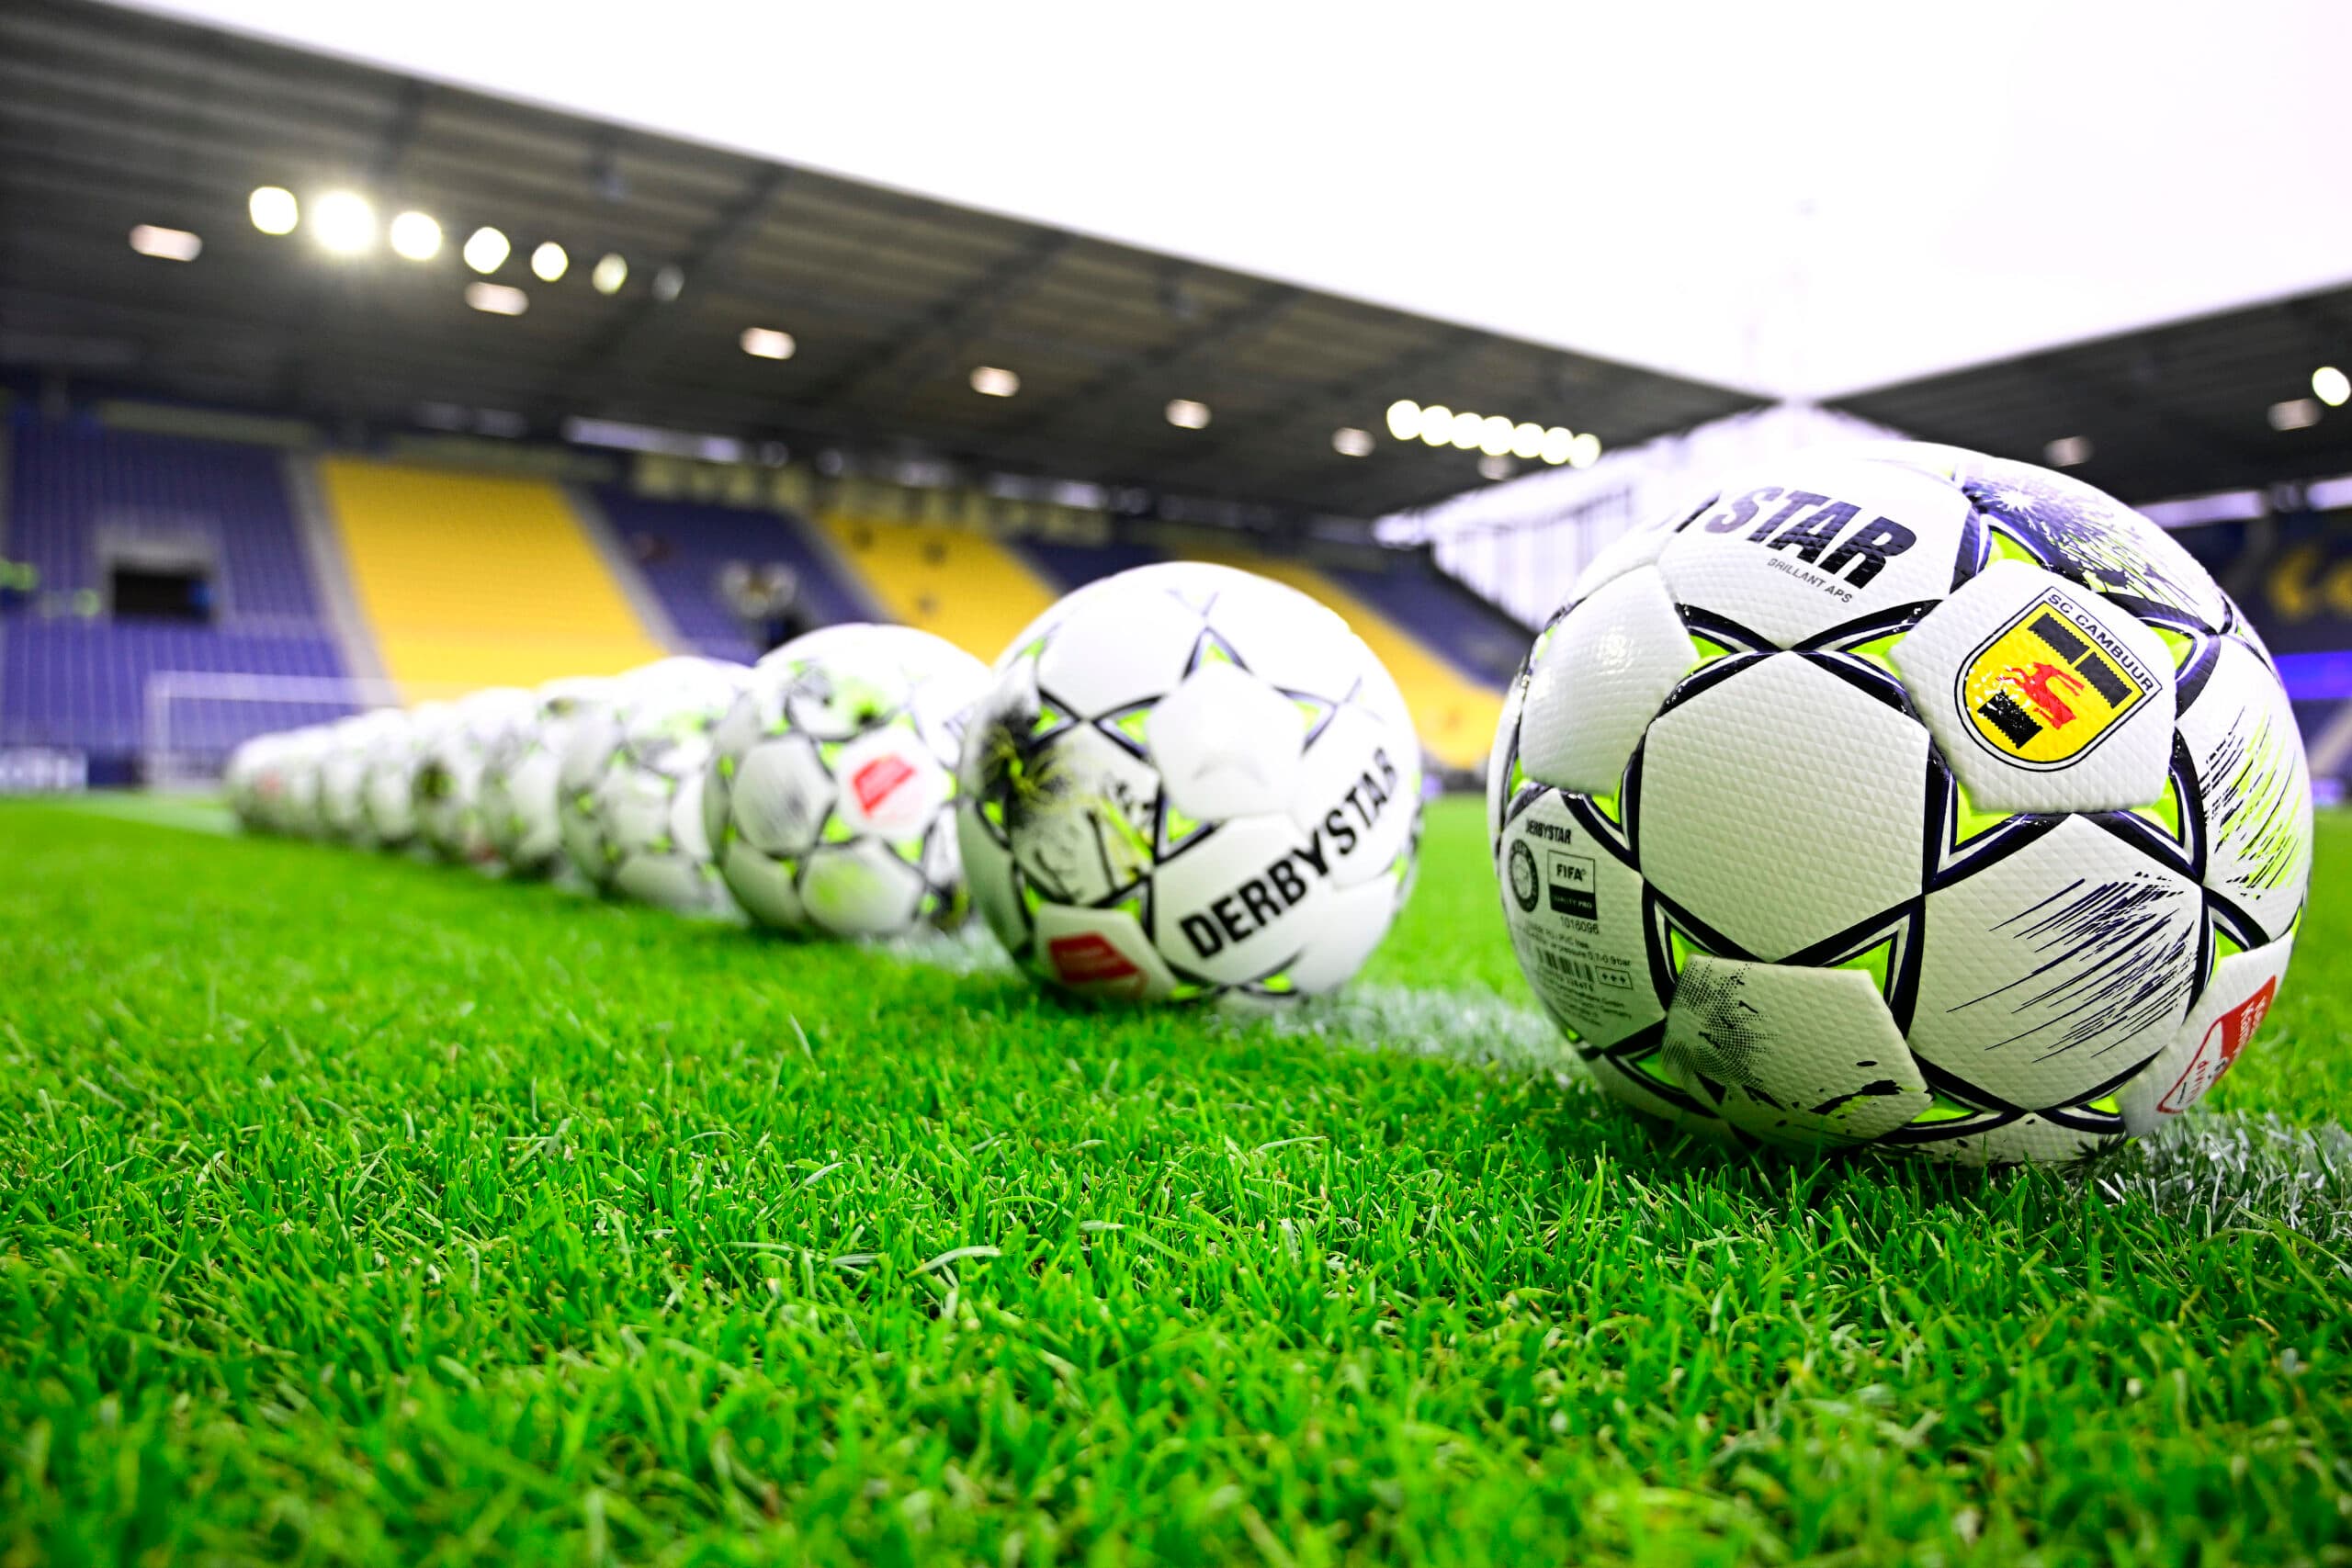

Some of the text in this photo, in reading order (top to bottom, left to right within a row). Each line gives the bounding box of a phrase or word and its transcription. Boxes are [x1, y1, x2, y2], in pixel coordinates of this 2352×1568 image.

[1766, 558, 1853, 604] BRILLANT APS
[2047, 593, 2154, 692] SC CAMBUUR
[1181, 747, 1398, 959] DERBYSTAR
[1577, 900, 1593, 910] PRO
